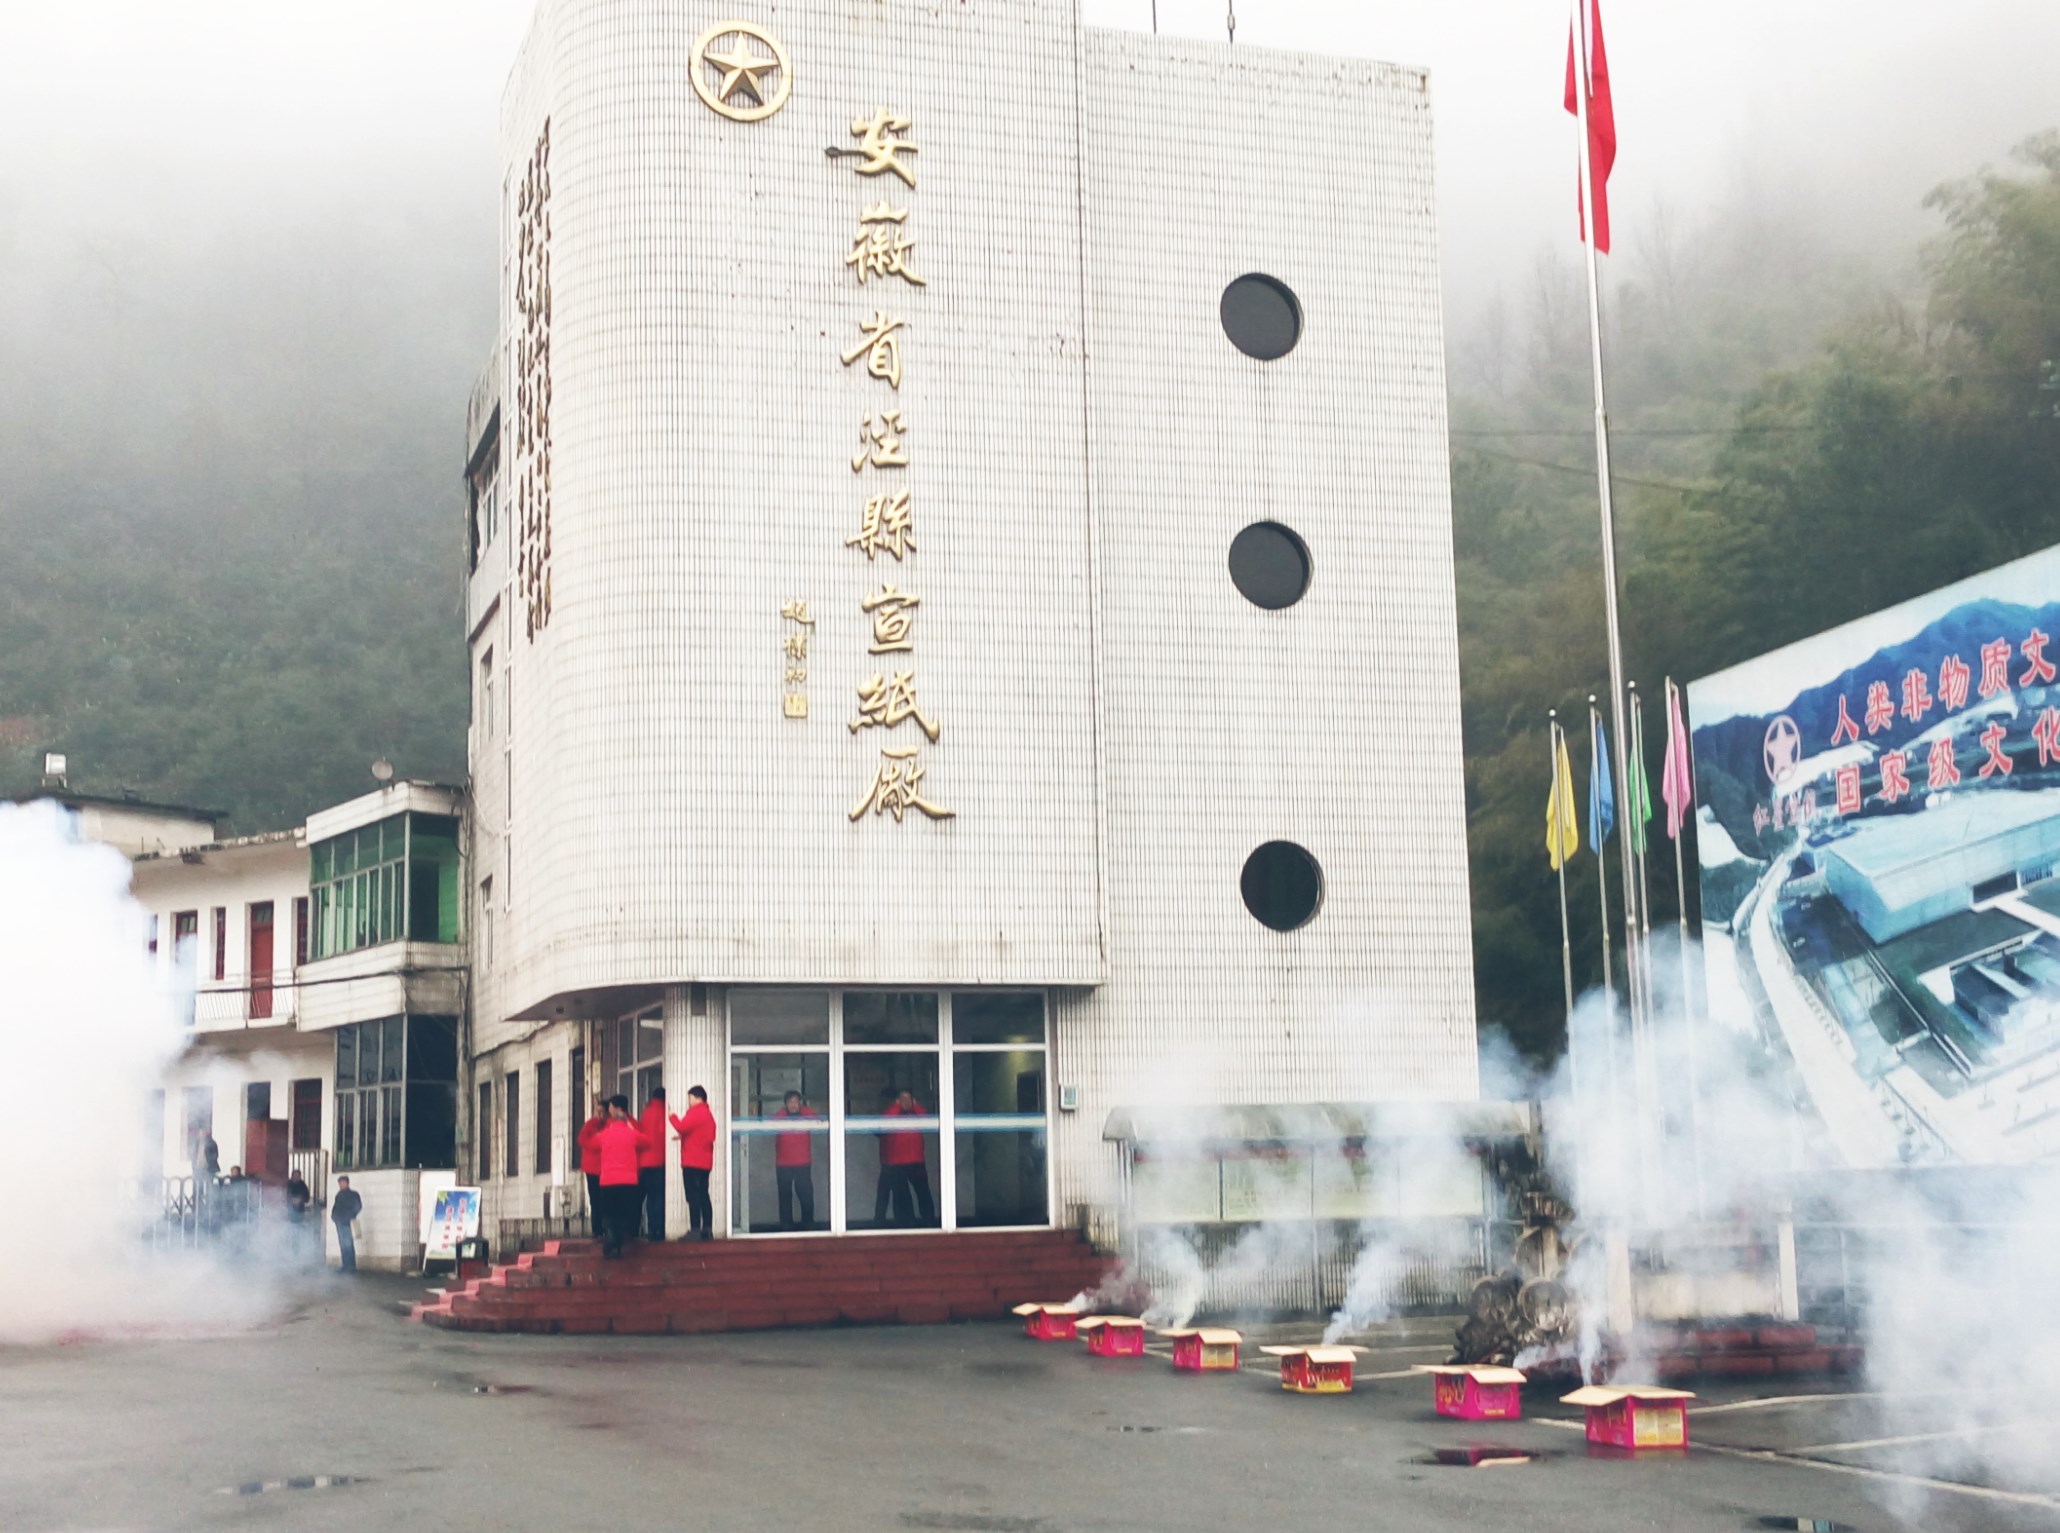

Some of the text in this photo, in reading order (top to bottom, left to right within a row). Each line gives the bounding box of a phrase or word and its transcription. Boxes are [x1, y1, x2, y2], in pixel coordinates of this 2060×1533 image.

[1831, 628, 2056, 746] 人类非物质文
[1835, 705, 2060, 816] 国家级文化
